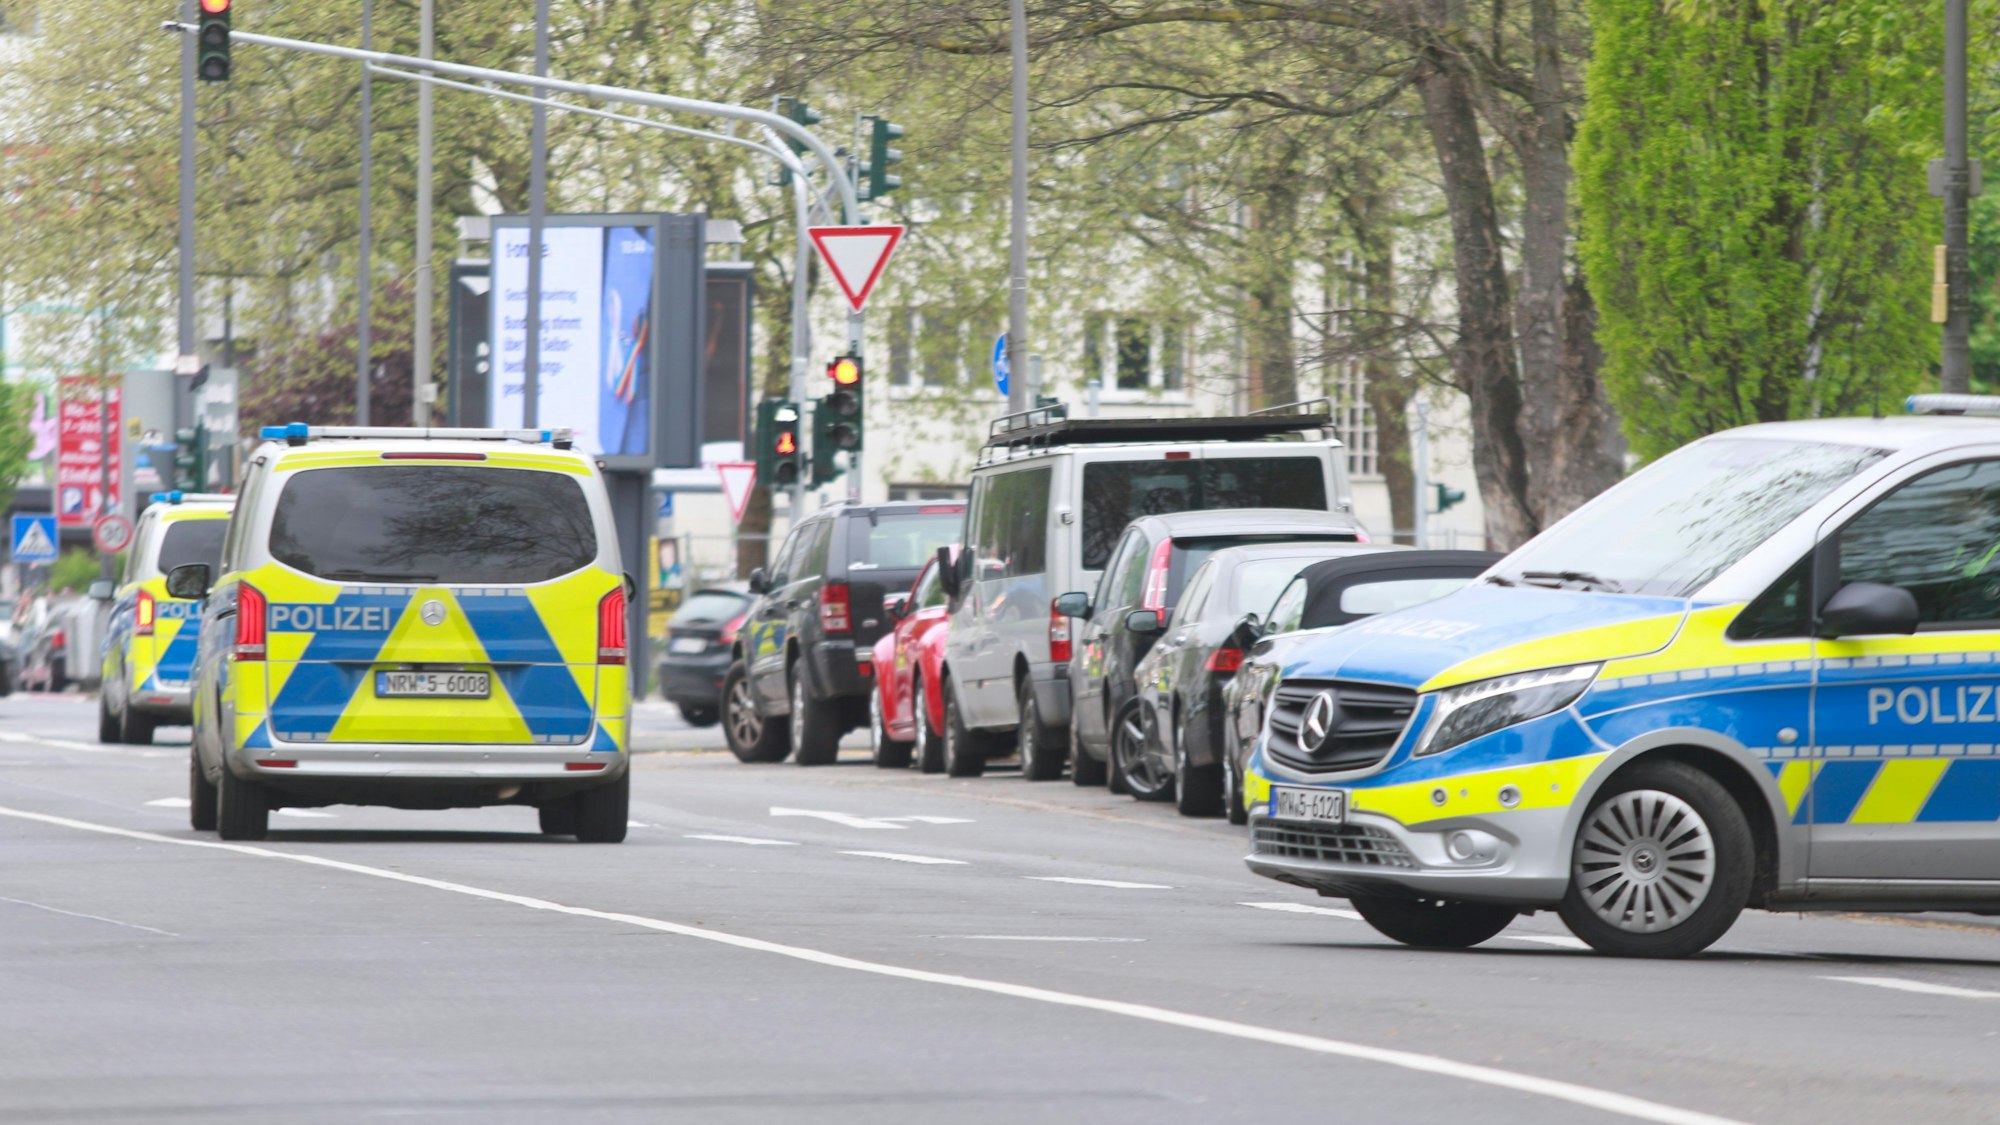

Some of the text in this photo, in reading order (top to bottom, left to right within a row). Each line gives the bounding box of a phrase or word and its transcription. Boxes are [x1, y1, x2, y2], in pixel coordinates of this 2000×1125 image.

[271, 606, 390, 631] POLIZEI
[428, 675, 487, 692] 5-6008
[1868, 685, 2000, 725] POLIZ
